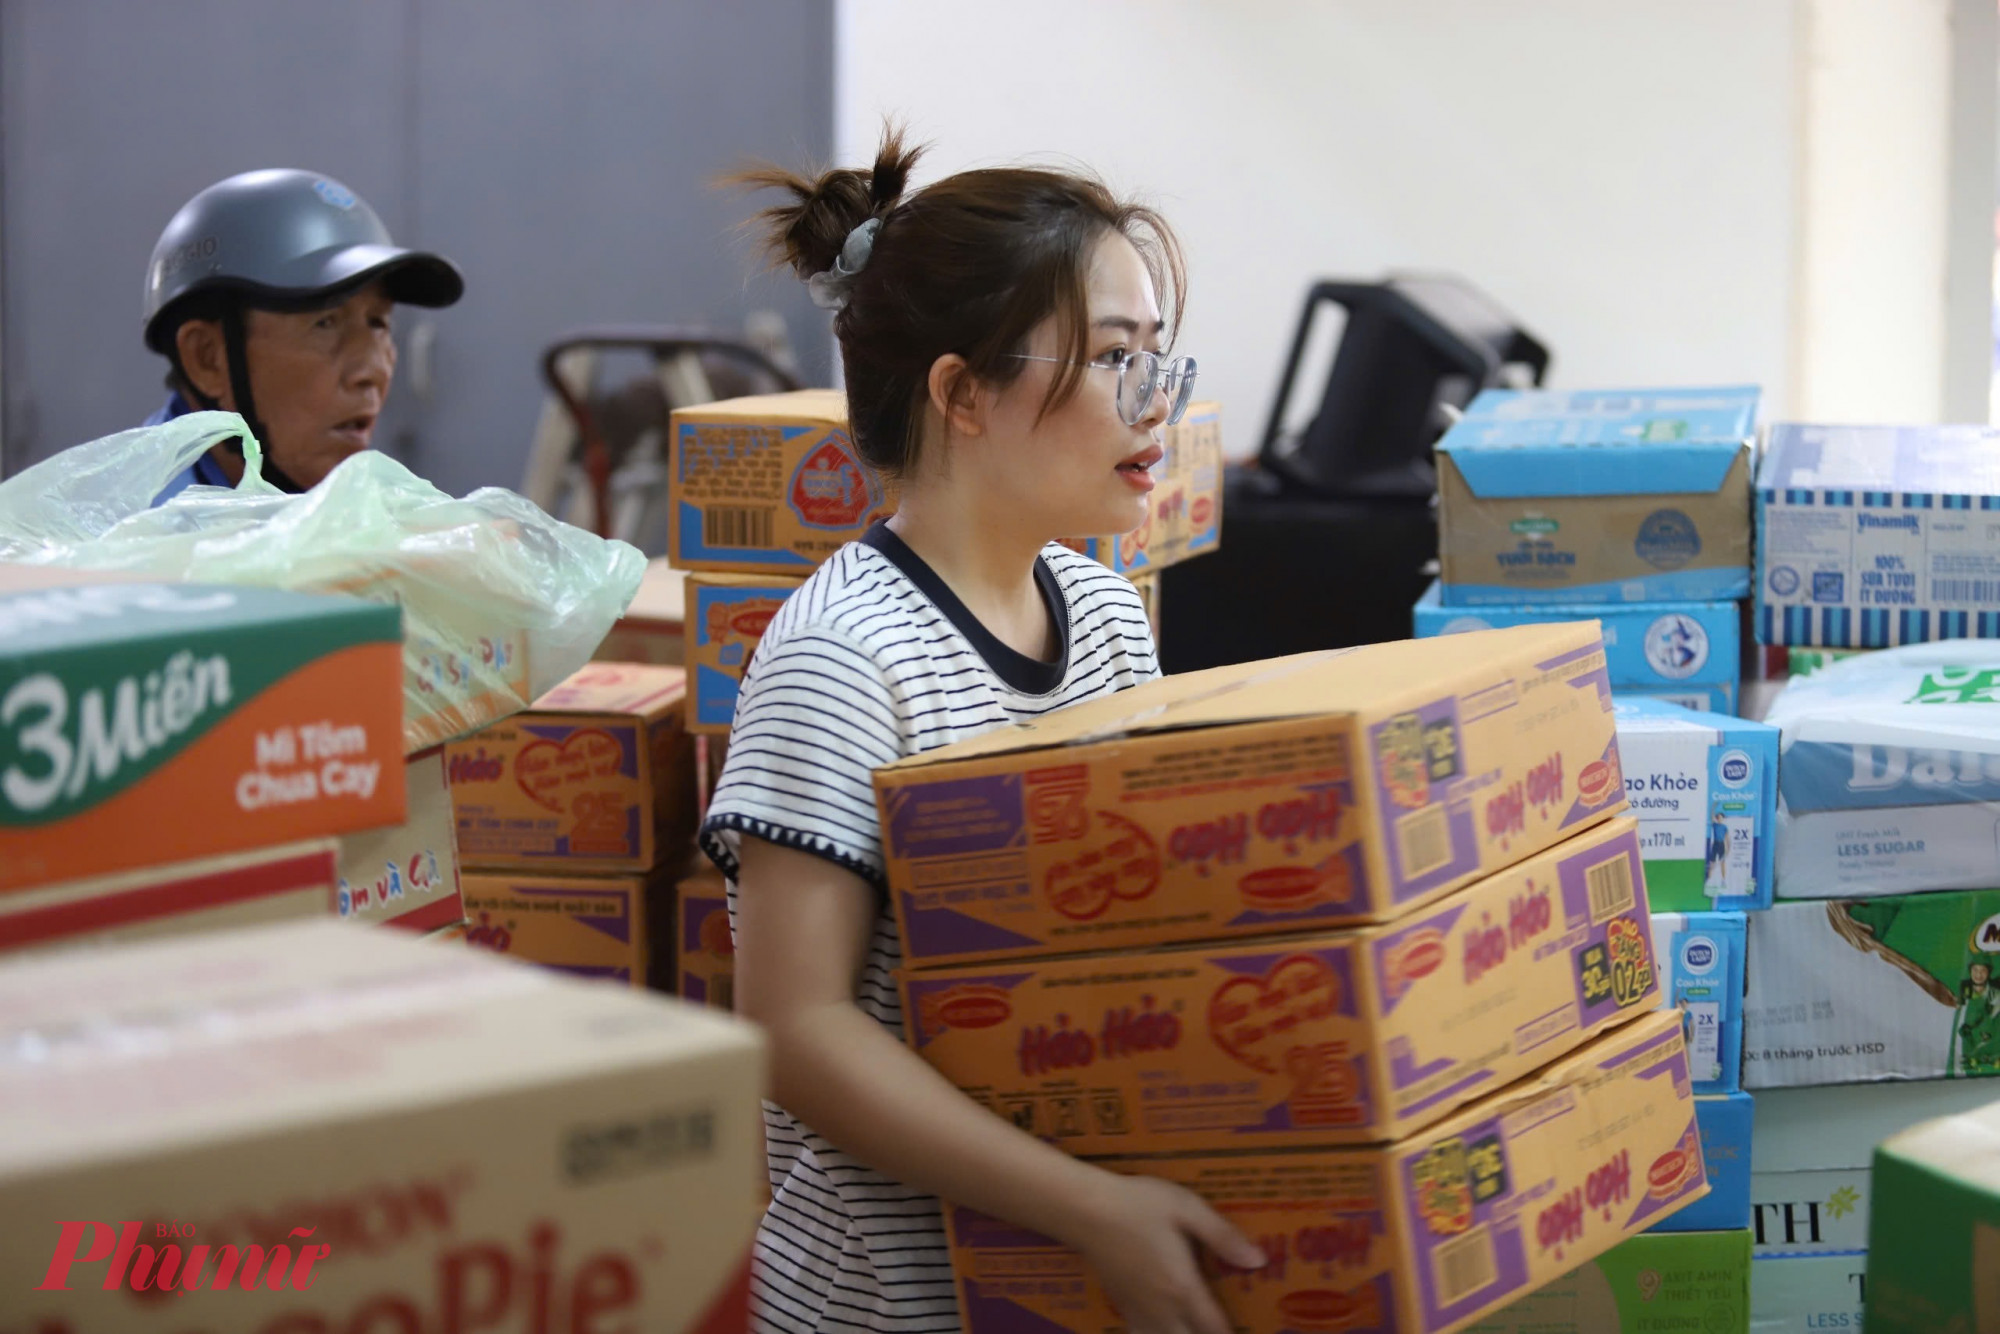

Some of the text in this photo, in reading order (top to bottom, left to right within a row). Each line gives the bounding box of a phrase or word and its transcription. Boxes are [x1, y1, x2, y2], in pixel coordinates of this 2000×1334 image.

[1857, 513, 1920, 533] Vinamilk
[1875, 555, 1906, 569] 100%
[1, 673, 73, 811] 3
[236, 760, 381, 811] Chua Cay
[1624, 777, 1645, 791] ao
[1650, 772, 1698, 791] Khỏe
[1733, 829, 1749, 841] 2X
[1838, 840, 1926, 857] LESS SUGAR
[339, 878, 370, 916] ôm
[1698, 1014, 1713, 1026] 2X
[1775, 1048, 1814, 1061] tháng
[1818, 1045, 1852, 1057] trước
[1855, 1042, 1885, 1054] HSD
[1752, 1202, 1824, 1245] TH
[1697, 1270, 1732, 1282] AMIN
[1808, 1313, 1849, 1328] LESS
